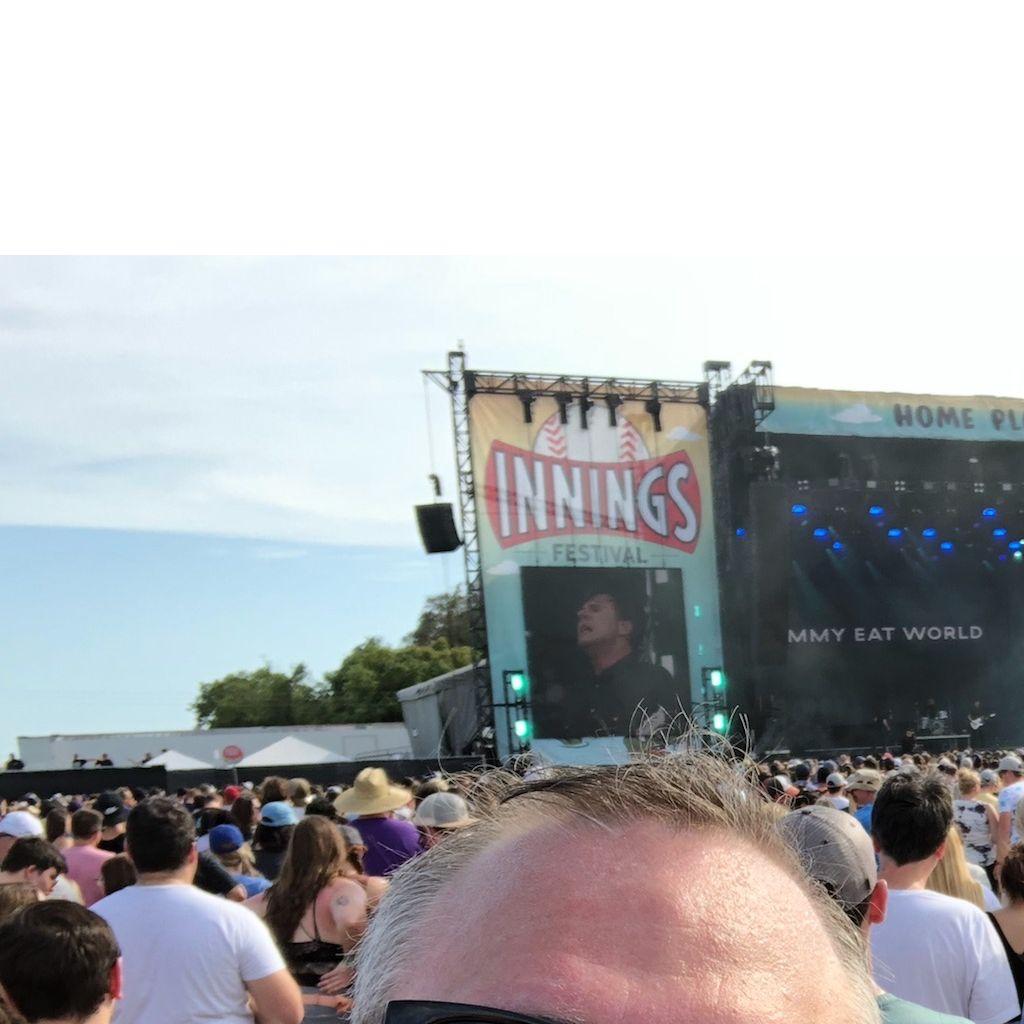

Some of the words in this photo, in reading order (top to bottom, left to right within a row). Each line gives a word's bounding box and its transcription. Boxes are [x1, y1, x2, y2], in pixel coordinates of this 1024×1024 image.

[894, 403, 975, 430] HOME
[494, 450, 698, 543] INNINGS
[552, 543, 649, 564] FESTIVAL
[787, 628, 846, 643] MMY
[854, 627, 896, 642] EAT
[902, 626, 983, 641] WORLD
